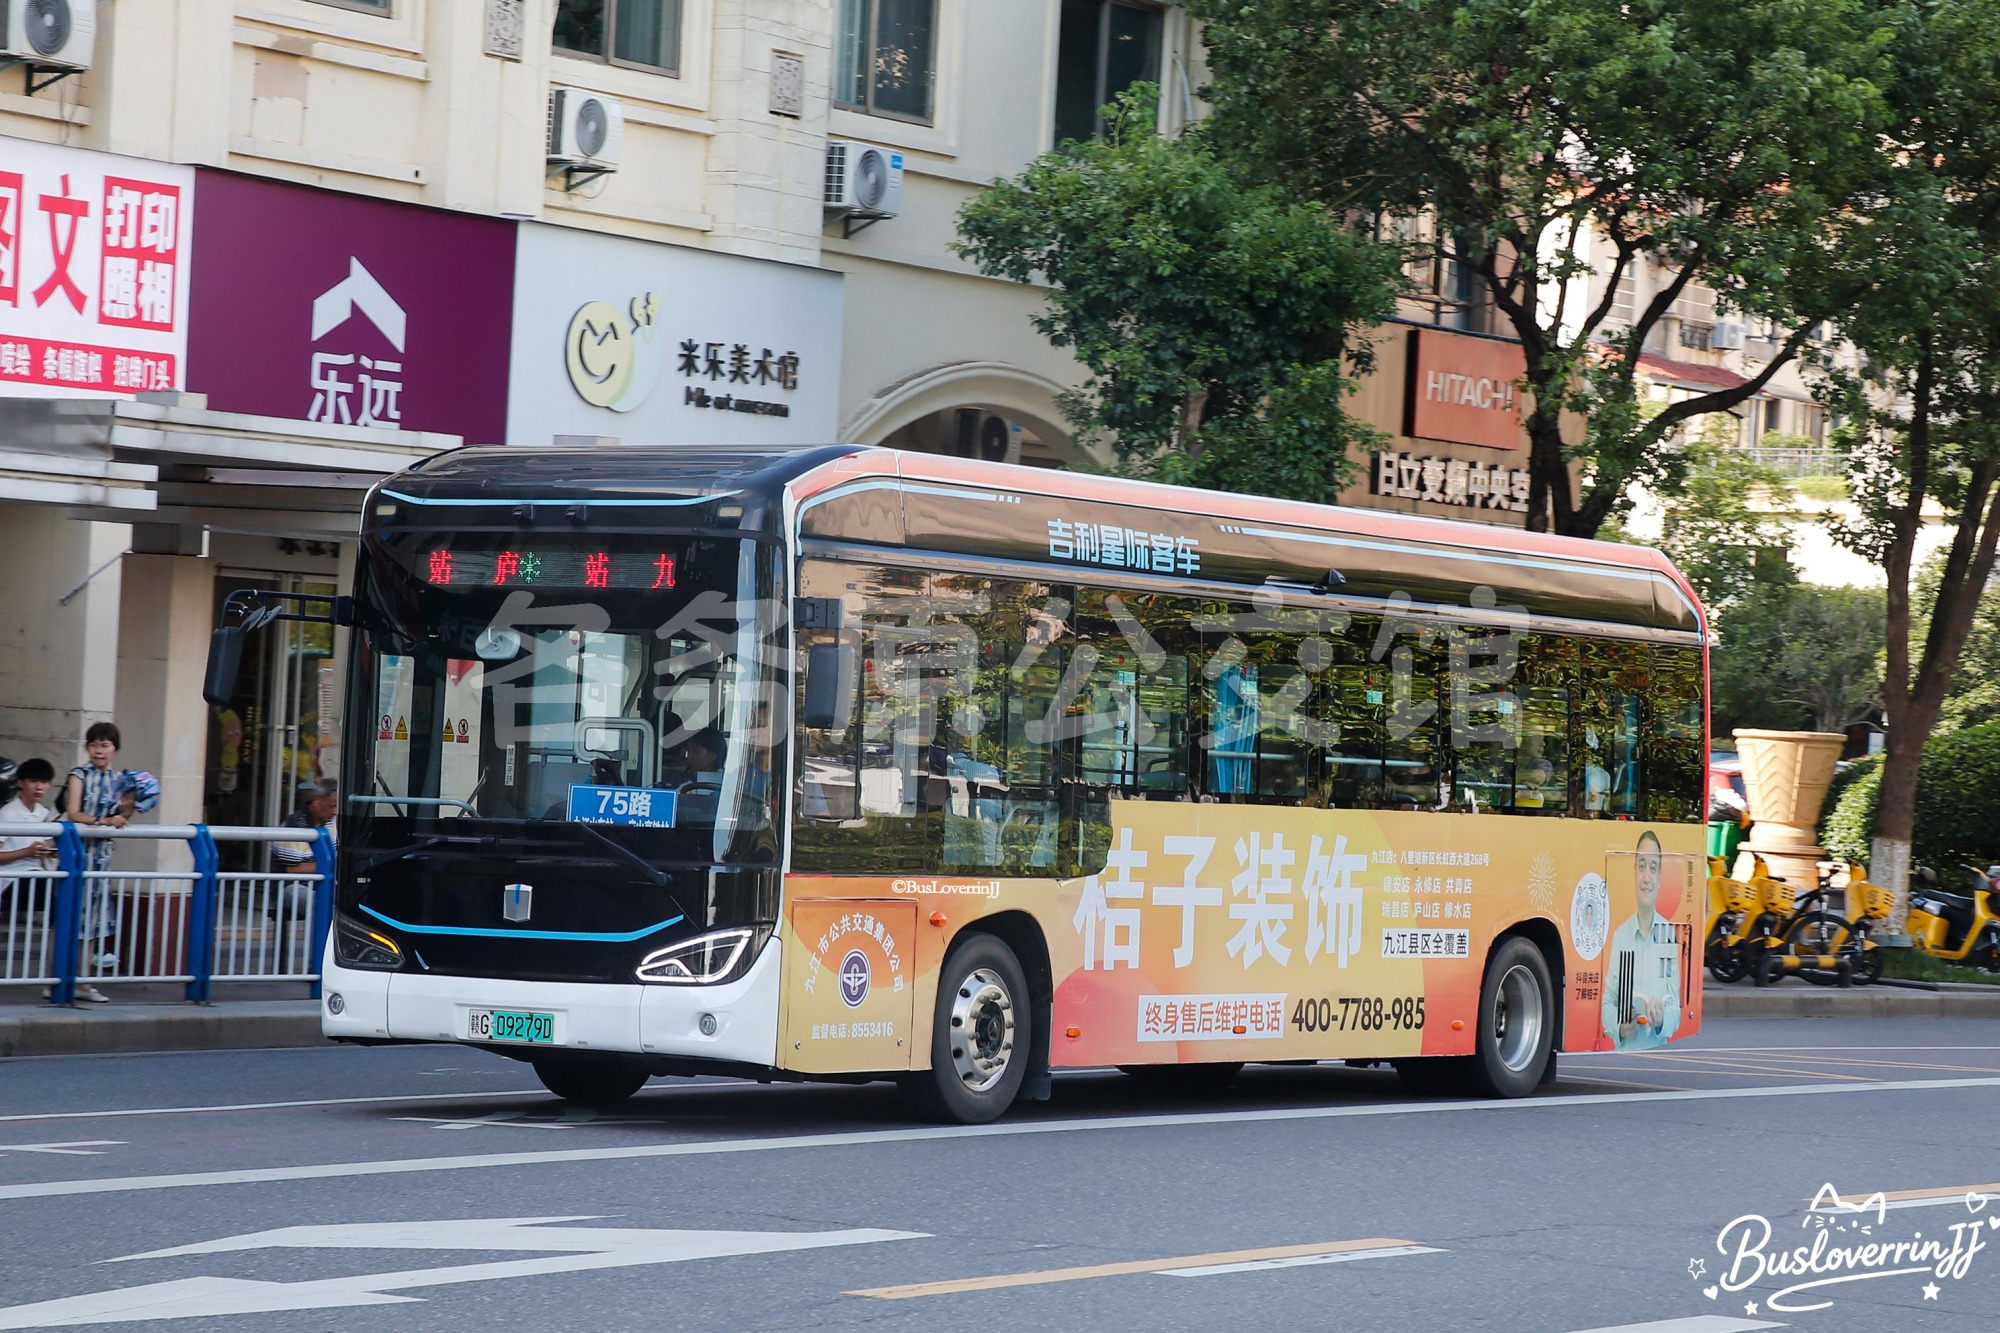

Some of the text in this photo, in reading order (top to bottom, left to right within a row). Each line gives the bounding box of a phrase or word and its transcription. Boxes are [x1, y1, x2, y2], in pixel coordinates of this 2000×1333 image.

[105, 186, 177, 254] 打印
[102, 257, 175, 324] 照相
[678, 338, 800, 390] 米乐美术馆
[307, 352, 402, 430] 乐远
[430, 551, 676, 588] 站 庐 站 九
[1047, 518, 1201, 575] 吉利星际客车
[597, 790, 652, 818] 75路
[1072, 828, 1368, 971] 桔子装饰
[1382, 901, 1472, 919] 瑞昌店 庐山店 修水店
[1383, 876, 1473, 895] 德安店 永修店 共青店
[804, 912, 904, 993] 九江市公共交通集团公司
[1383, 931, 1468, 955] 九江县区全覆盖
[1144, 997, 1426, 1035] 终身售后维护电话 400-7788-985
